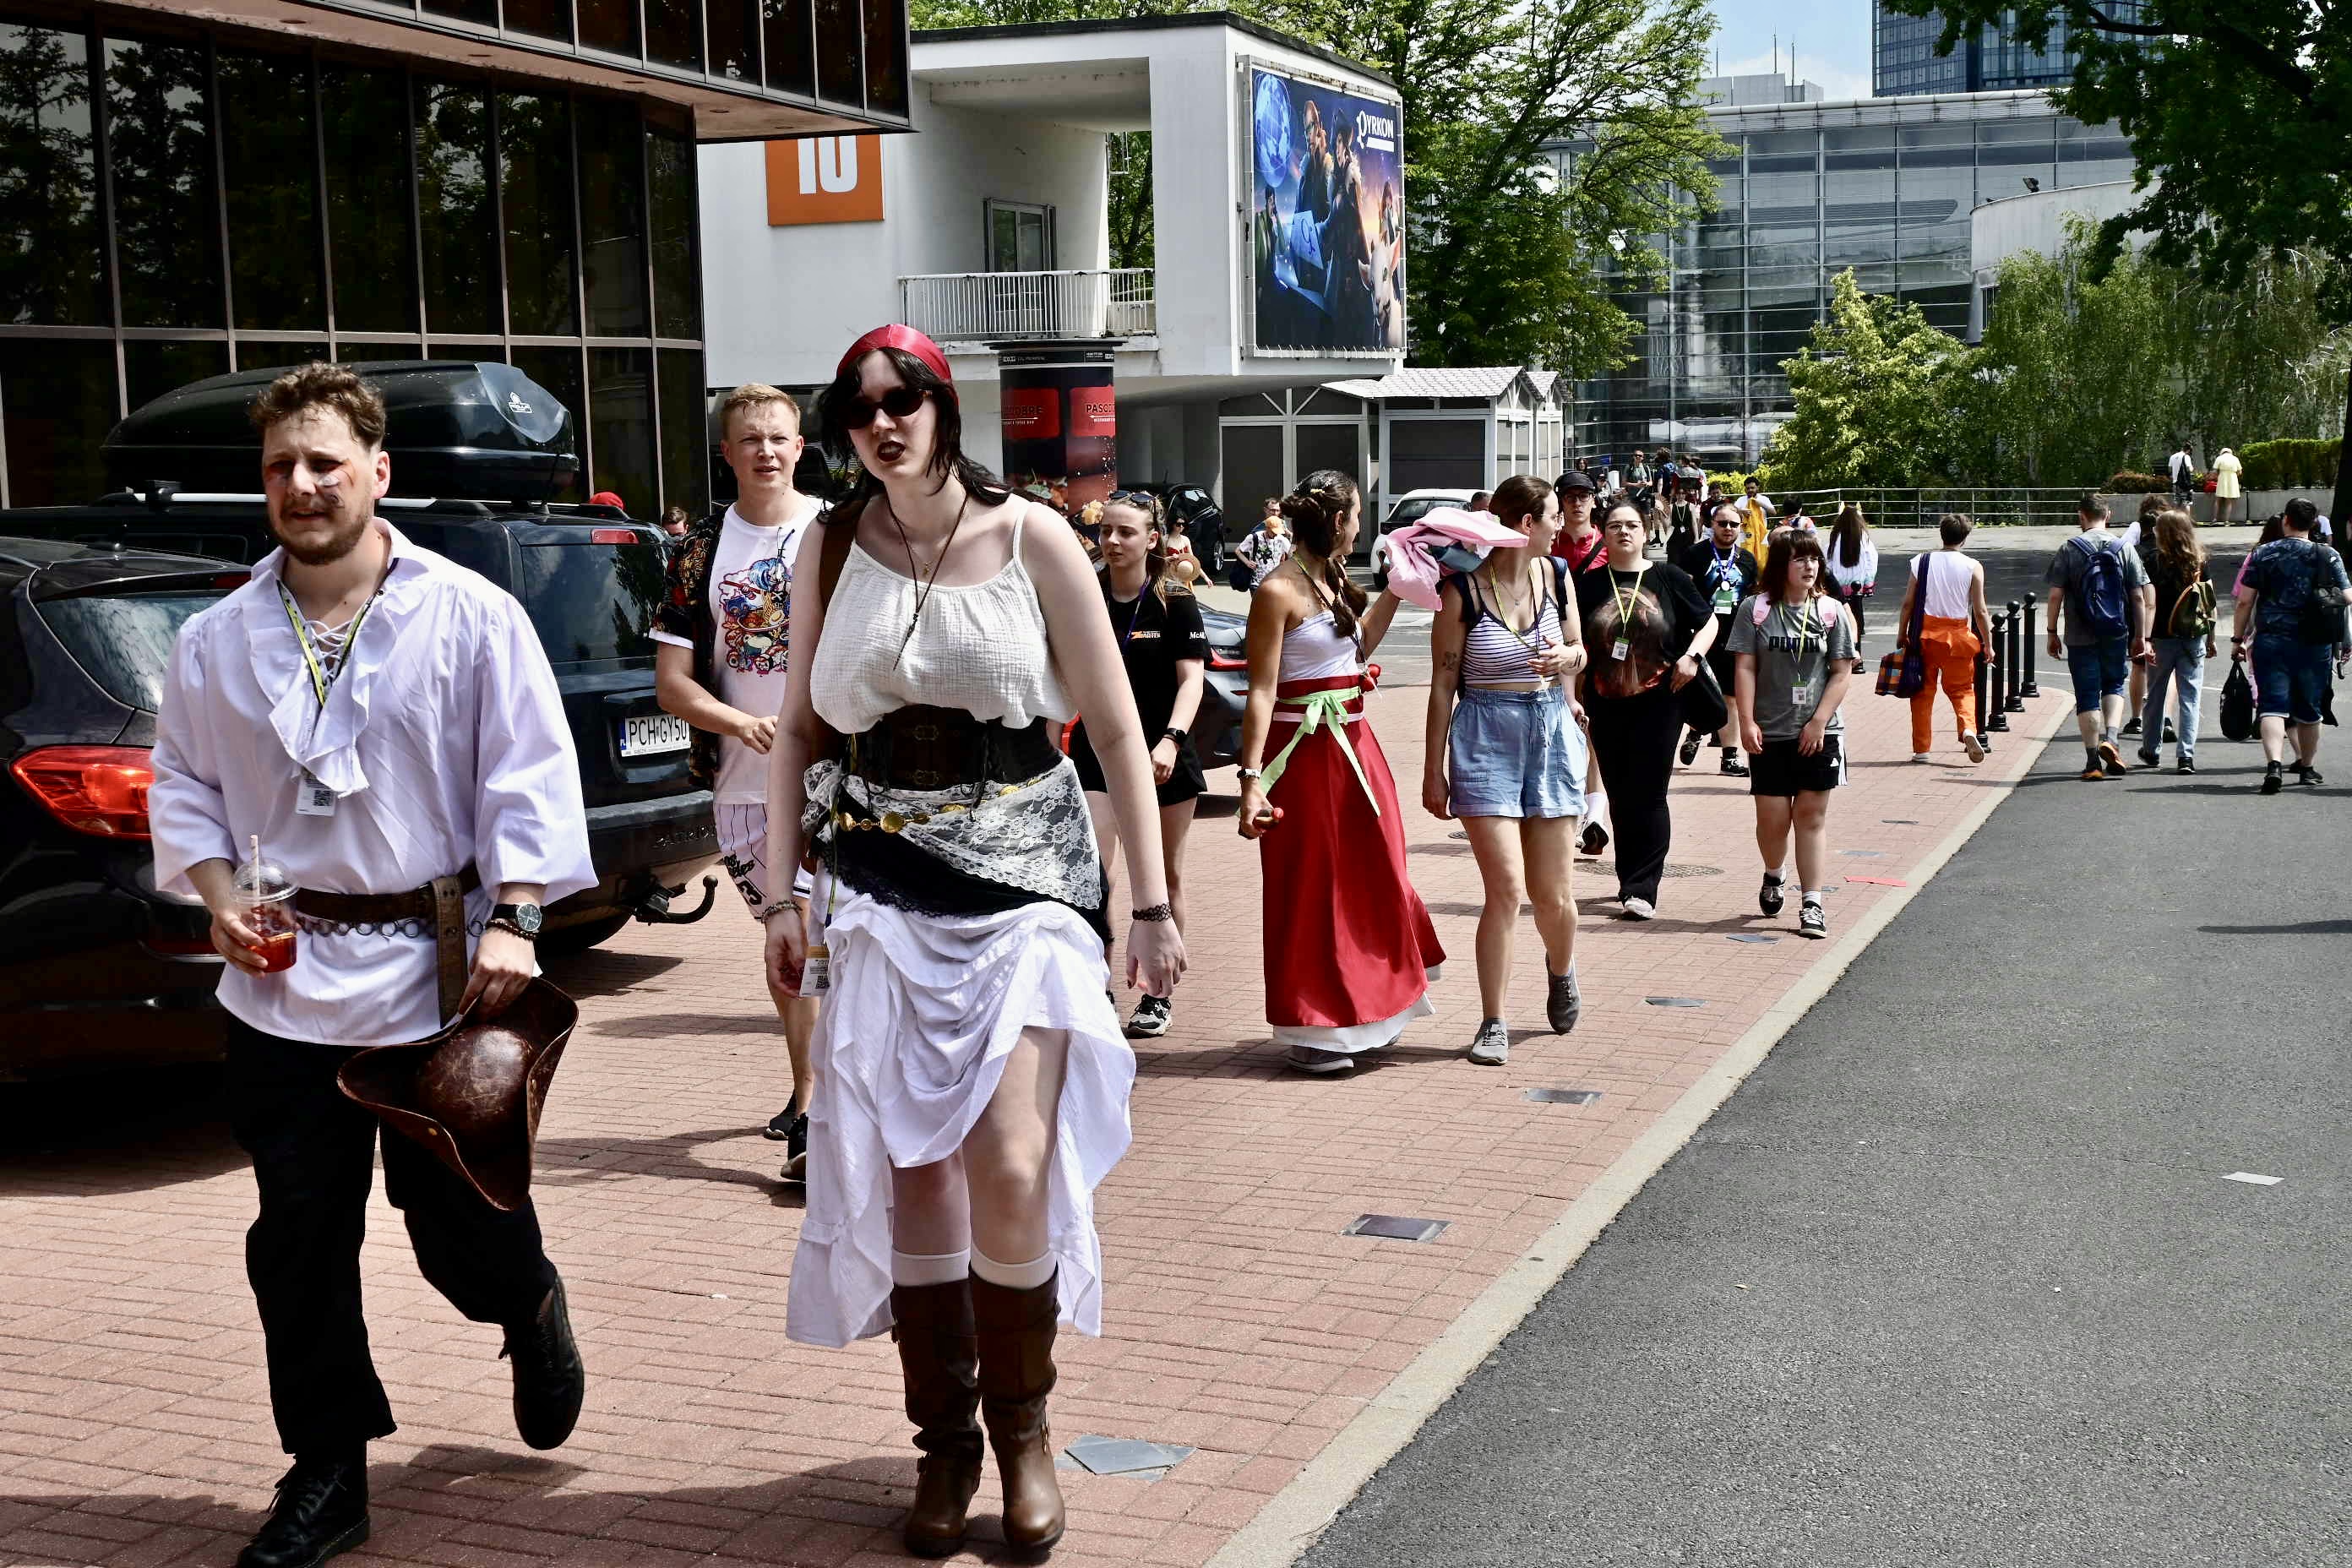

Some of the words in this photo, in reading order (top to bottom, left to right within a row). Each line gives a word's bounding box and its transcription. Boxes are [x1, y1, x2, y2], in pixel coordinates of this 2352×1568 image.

[1356, 111, 1394, 149] PYRKON
[798, 135, 858, 194] 10
[629, 718, 656, 748] PCH
